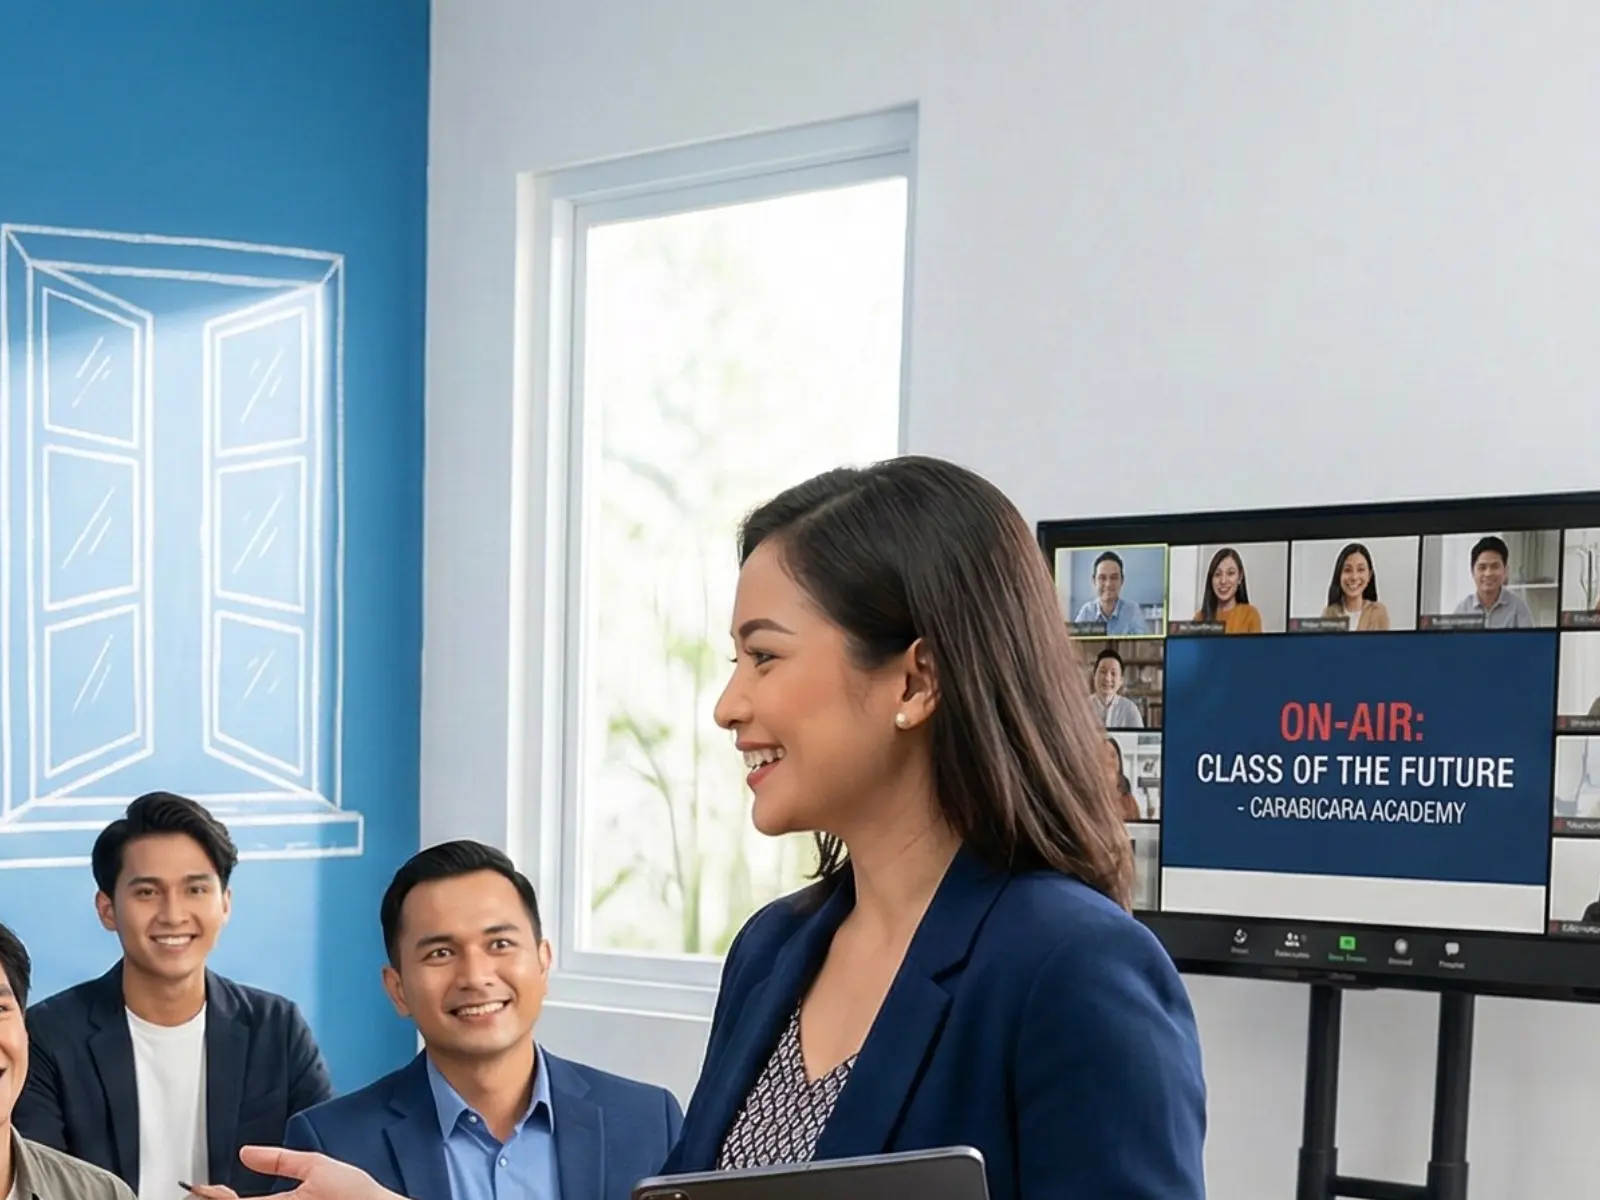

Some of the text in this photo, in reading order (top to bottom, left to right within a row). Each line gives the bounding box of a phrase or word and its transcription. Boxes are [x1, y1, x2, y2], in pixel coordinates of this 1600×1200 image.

[1280, 702, 1424, 741] ON-AIR:
[1197, 754, 1514, 788] CLASS OF THE FUTURE
[1250, 797, 1367, 821] CARABICARA
[1370, 800, 1466, 825] ACADEMY
